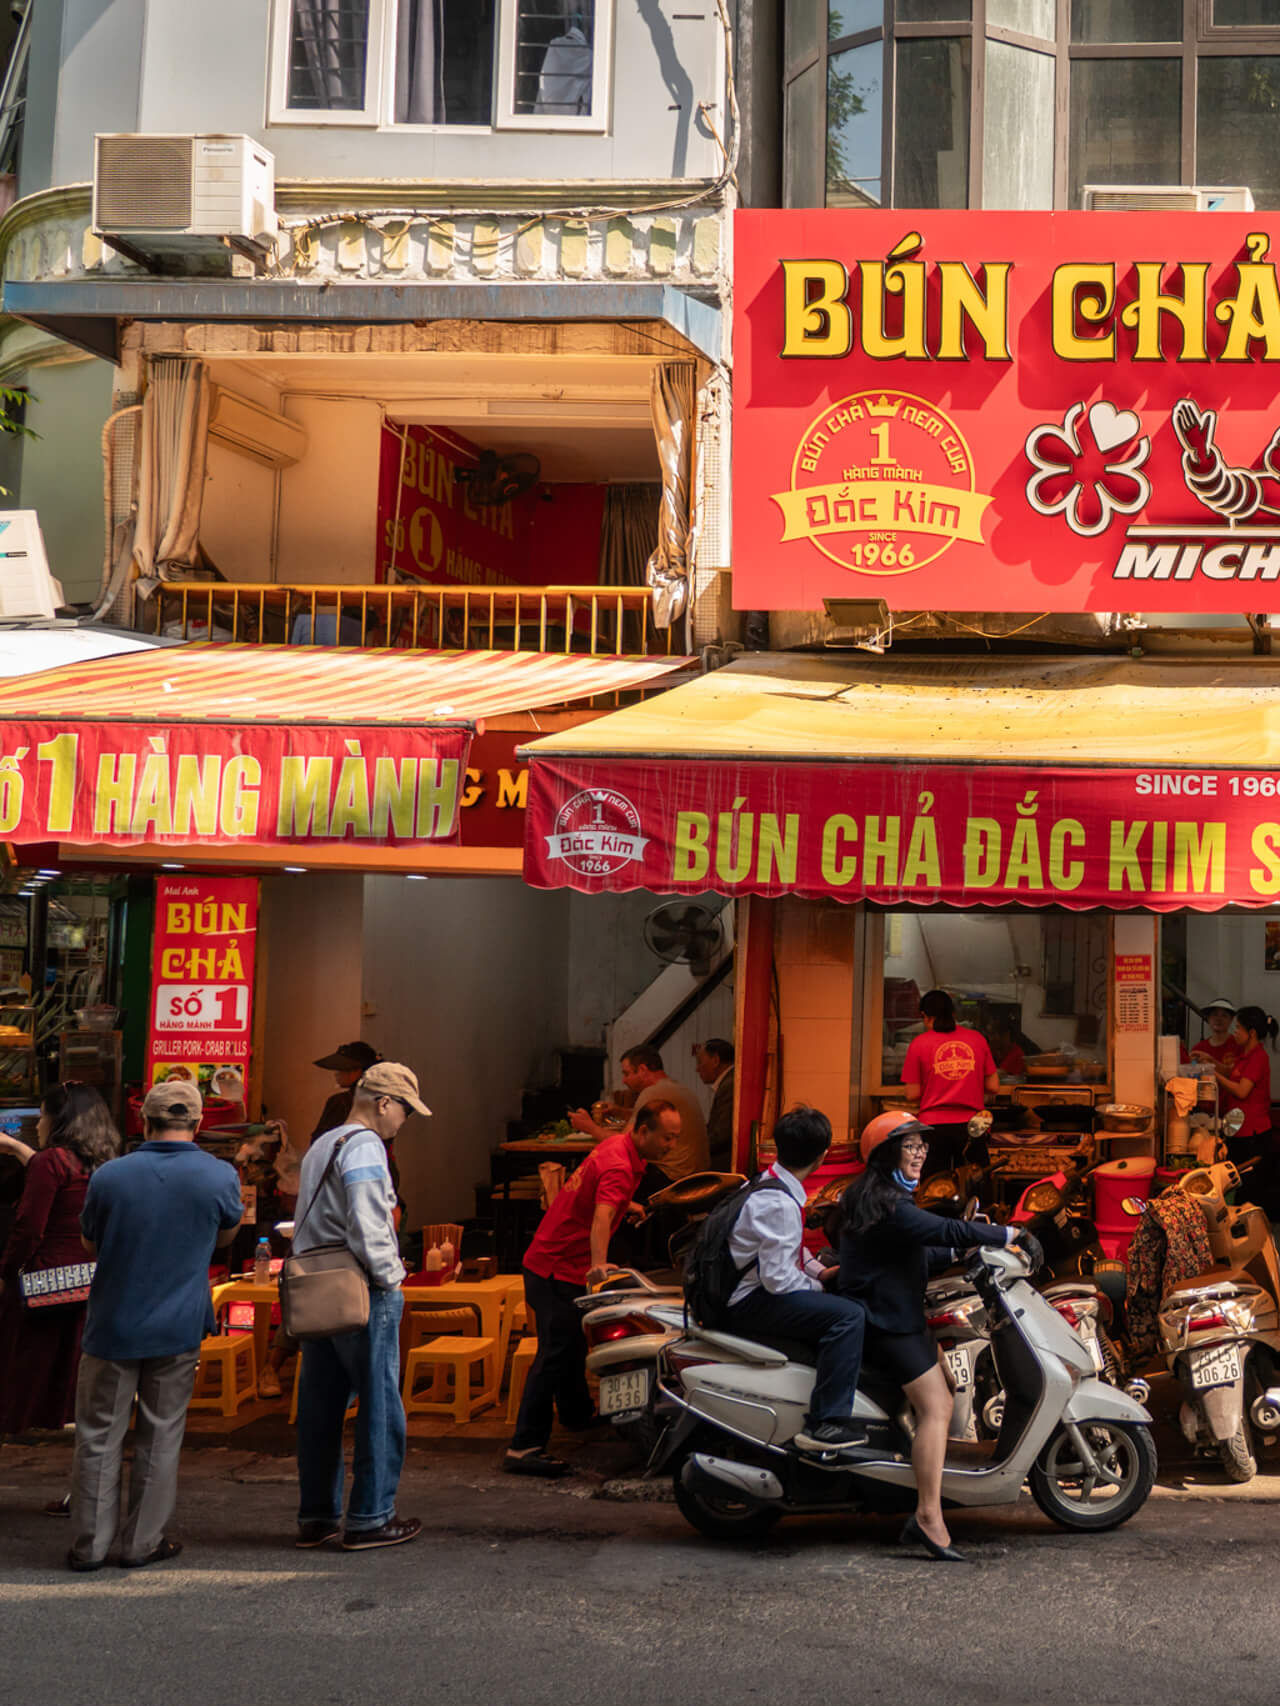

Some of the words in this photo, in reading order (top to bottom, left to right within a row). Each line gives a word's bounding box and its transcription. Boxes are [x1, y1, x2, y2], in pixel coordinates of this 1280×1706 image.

[779, 231, 1014, 362] BÚN
[801, 432, 829, 473] BÚN
[827, 399, 864, 434] CHẢ
[870, 422, 897, 464] 1
[940, 436, 967, 474] CUA
[843, 465, 879, 481] HÀNG
[883, 464, 923, 481] MÀNH
[806, 486, 878, 528] Đắc
[893, 489, 960, 529] Kim
[868, 533, 897, 542] SINCE
[851, 543, 914, 566] 1966
[38, 733, 79, 833] 1
[94, 736, 262, 837] HÀNG
[276, 739, 459, 838] MÀNH
[1135, 774, 1218, 796] SINCE
[592, 803, 606, 824] 1
[601, 835, 634, 855] Kim
[672, 796, 800, 885] BÚN
[821, 791, 942, 888] CHẢ
[963, 790, 1086, 890] ĐẮC
[1108, 820, 1227, 893] KIM
[580, 859, 611, 872] 1966
[166, 896, 249, 935] BÚN
[161, 939, 246, 980] CHẢ
[169, 989, 204, 1016] SỐ
[213, 987, 243, 1029] 1
[225, 1040, 247, 1056] RLLS
[1197, 1362, 1238, 1385] 306.26
[607, 1391, 641, 1409] 4536
